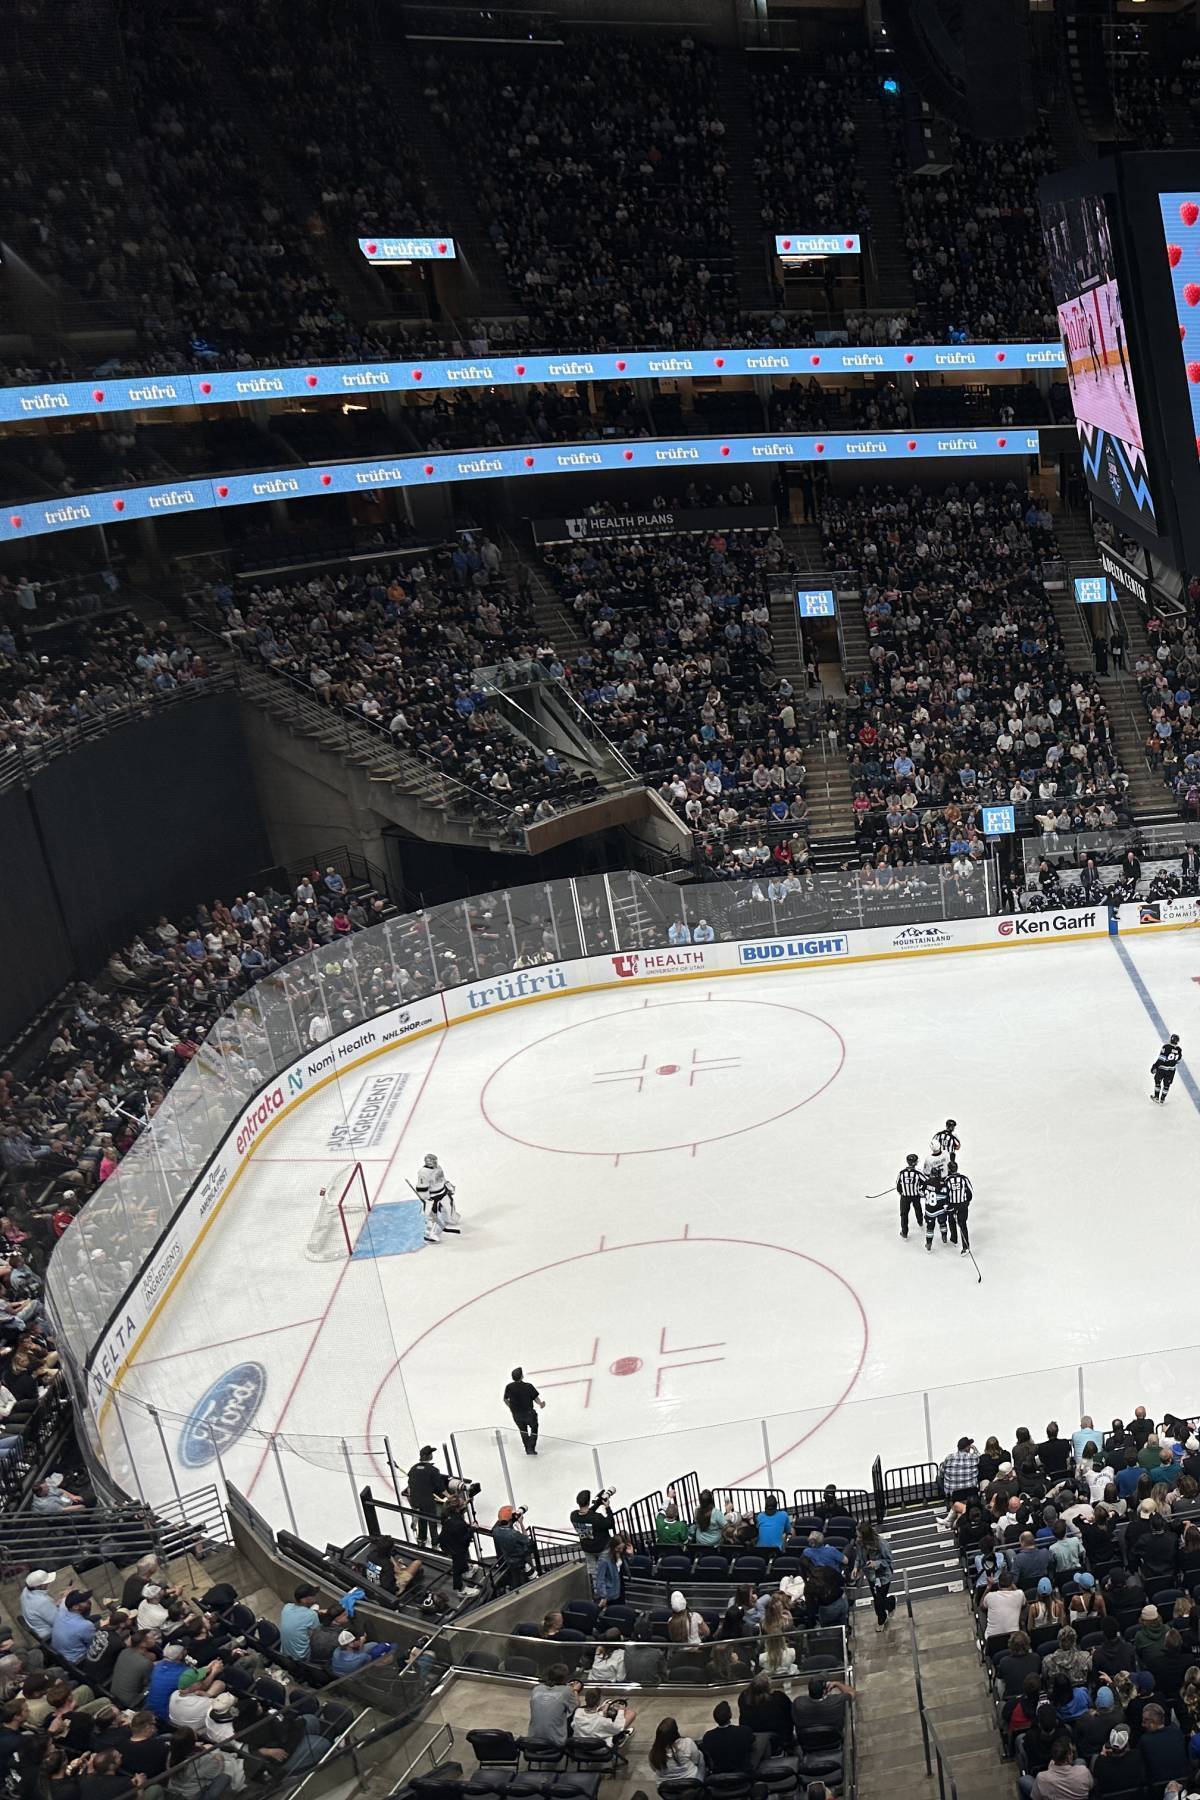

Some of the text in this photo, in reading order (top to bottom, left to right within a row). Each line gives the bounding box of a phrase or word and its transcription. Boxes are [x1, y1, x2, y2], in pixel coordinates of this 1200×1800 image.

[746, 355, 789, 368] trüfrü
[841, 353, 884, 366] trüfrü
[935, 351, 976, 363] trüfrü
[1025, 349, 1065, 362] trüfrü
[447, 364, 493, 380] trüfrü
[548, 361, 594, 375] trüfrü
[648, 358, 693, 371] trüfrü
[236, 377, 284, 393] trüfrü
[342, 370, 390, 386] trüfrü
[128, 384, 177, 401] trüfrü
[21, 392, 69, 411] trüfrü
[752, 443, 794, 456] trüfrü
[846, 440, 887, 453] trüfrü
[937, 438, 977, 451] trüfrü
[557, 452, 601, 466] trüfrü
[655, 447, 699, 460] trüfrü
[457, 459, 502, 474] trüfrü
[356, 468, 402, 484] trüfrü
[252, 478, 299, 495] trüfrü
[149, 490, 195, 508] trüfrü
[44, 505, 91, 525] trüfrü
[590, 514, 674, 529] HEALTH PLANS
[1015, 913, 1096, 934] Ken Garff
[893, 935, 951, 947] MOUNTAINLAND
[743, 938, 844, 961] BUD LIGHT
[645, 952, 704, 967] HEALTH
[466, 967, 568, 1009] trüfrü
[308, 1052, 335, 1076] Nomi
[338, 1031, 376, 1058] Health
[346, 1076, 393, 1146] INGREDIENTS
[236, 1087, 284, 1154] entrata
[326, 1122, 350, 1148] JUST
[93, 1315, 136, 1397] DELTA
[192, 1381, 257, 1444] Ford
